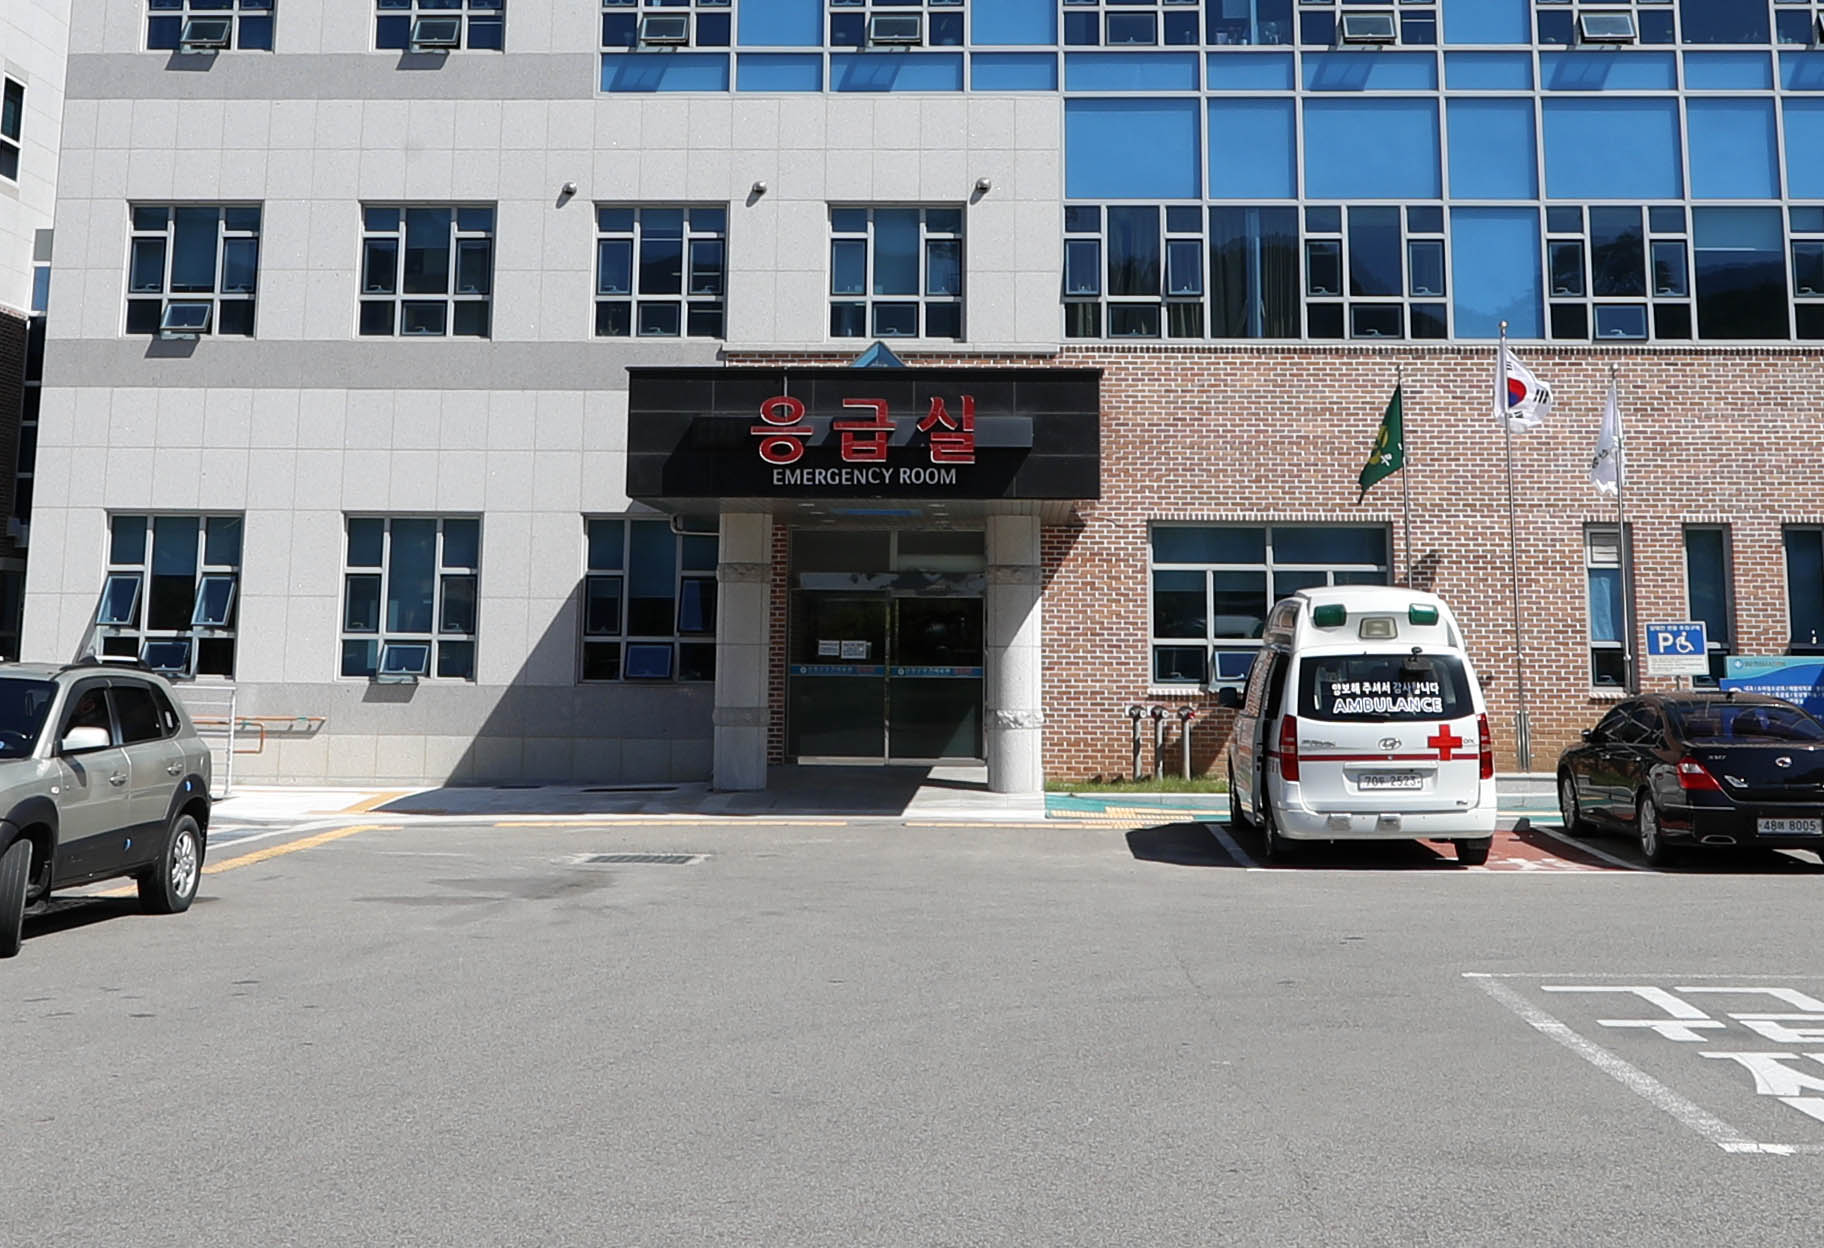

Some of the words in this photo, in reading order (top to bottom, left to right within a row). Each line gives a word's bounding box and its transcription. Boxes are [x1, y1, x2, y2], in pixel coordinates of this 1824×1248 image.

[750, 394, 976, 465] 응급실
[772, 467, 894, 486] EMERGENCY
[899, 467, 957, 485] ROOM
[1657, 632, 1674, 654] P
[1333, 697, 1443, 714] AMBULANCE
